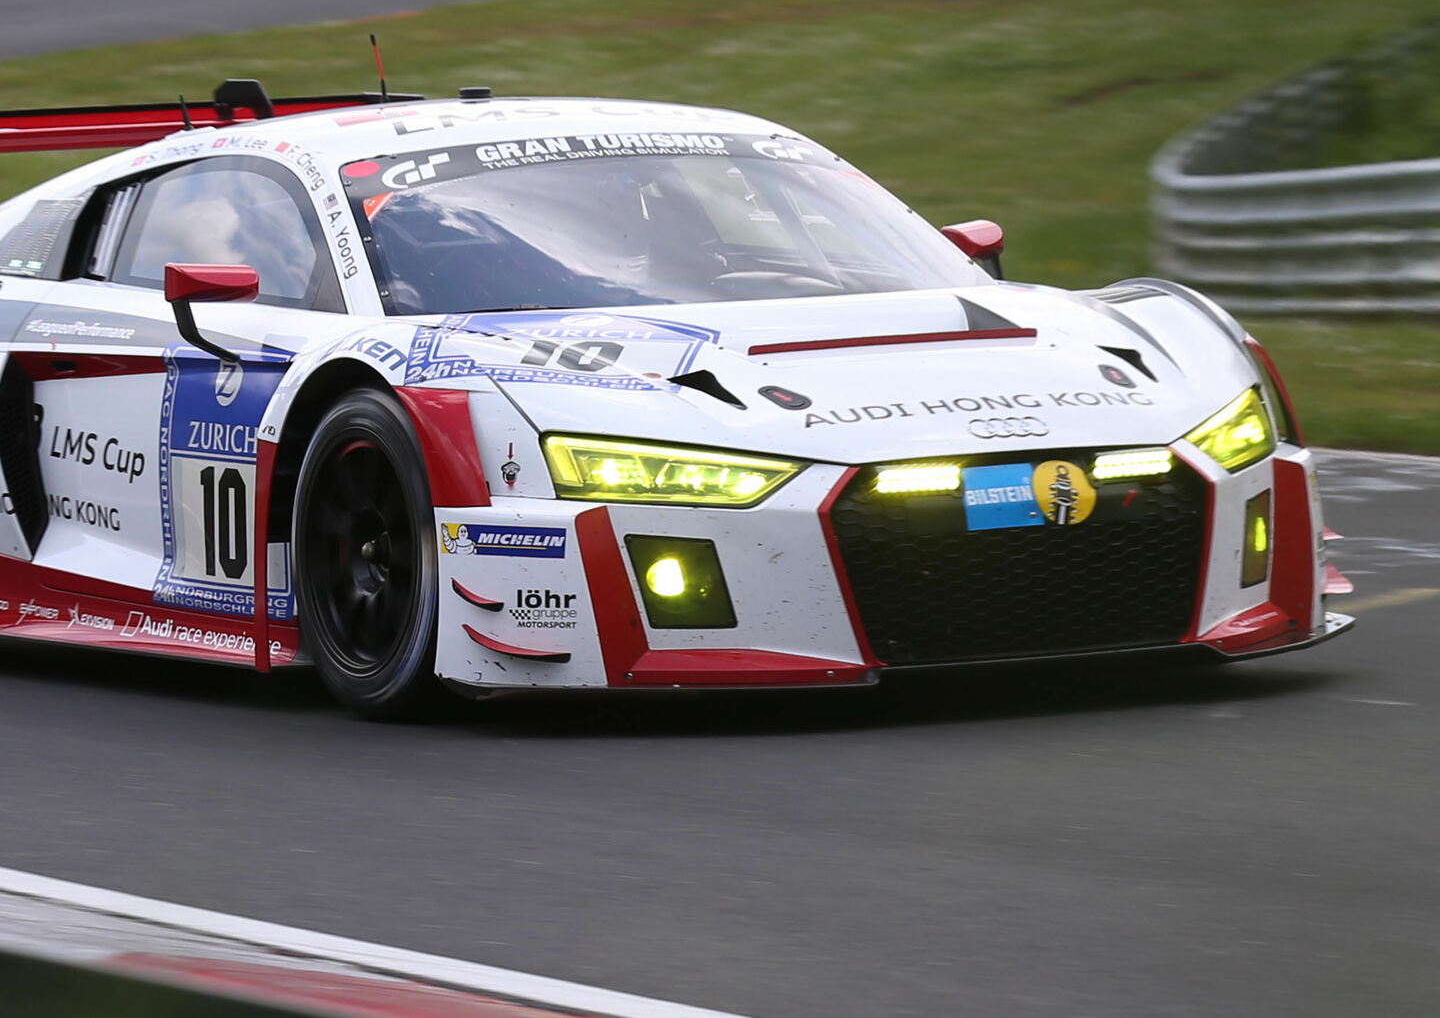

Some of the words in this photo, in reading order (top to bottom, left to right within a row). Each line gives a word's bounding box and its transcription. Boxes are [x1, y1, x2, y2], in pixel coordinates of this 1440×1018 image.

[475, 137, 573, 164] GRAN
[576, 132, 727, 152] TURISMO
[482, 157, 520, 170] THE
[521, 153, 566, 166] REAL
[565, 148, 636, 160] DRIVING
[635, 146, 732, 157] SIMULATOR
[296, 151, 326, 192] Cheng
[326, 210, 343, 228] A.
[334, 225, 359, 281] Yoong
[520, 339, 625, 372] 10
[804, 400, 913, 429] AUDI
[921, 393, 1043, 416] HONG
[1048, 391, 1155, 406] KONG
[187, 420, 258, 455] ZURICH
[50, 425, 98, 465] LMS
[102, 437, 146, 483] Cup
[966, 485, 1034, 506] BILSTEIN
[75, 499, 121, 531] KONG
[200, 466, 248, 579] 10
[477, 532, 565, 547] MICHELIN
[516, 589, 577, 609] löhr
[532, 609, 577, 620] gruppe
[140, 615, 173, 637] Audi
[173, 625, 202, 642] race
[516, 621, 577, 629] MOTORSPORT
